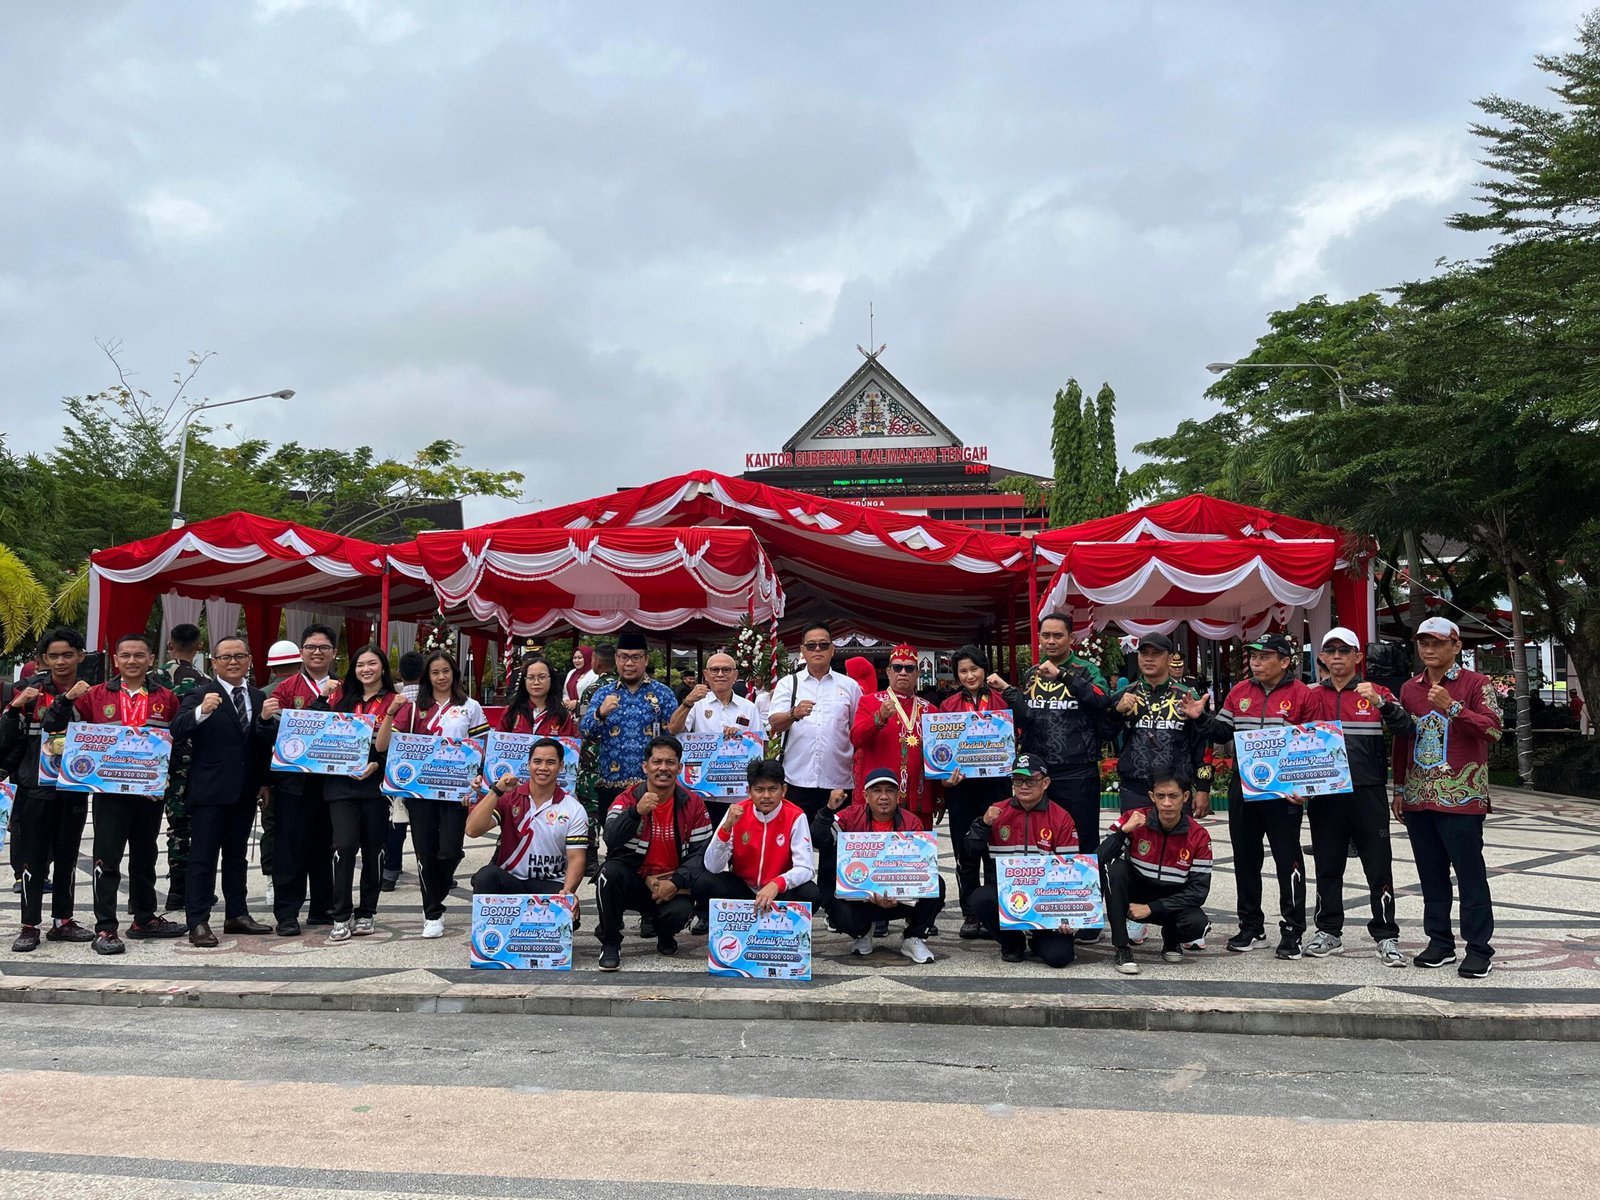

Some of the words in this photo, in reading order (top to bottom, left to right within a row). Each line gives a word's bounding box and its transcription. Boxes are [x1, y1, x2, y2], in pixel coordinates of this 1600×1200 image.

[746, 452, 793, 467] KANTOR
[796, 450, 856, 467] GUBERNUR
[861, 448, 937, 465] KALIMANTAN
[941, 446, 987, 462] TENGAH
[1024, 700, 1078, 709] ALTENG
[287, 719, 325, 729] BONUS
[930, 722, 966, 732] BONUS
[74, 734, 118, 745] BONUS
[1245, 738, 1286, 751] BONUS
[396, 743, 434, 754] BONUS
[494, 742, 531, 752] BONUS
[683, 742, 718, 751] BONUS
[1253, 748, 1281, 758] ATLET
[1279, 757, 1309, 768] Medali
[1309, 755, 1335, 765] Perak
[846, 841, 885, 850] BONUS
[1006, 867, 1045, 877] BONUS
[1035, 888, 1060, 896] Medali
[1060, 888, 1092, 898] Perunggu
[481, 906, 520, 916] BONUS
[487, 917, 515, 925] ATLET
[718, 912, 757, 922] BONUS
[723, 923, 752, 931] ATLET
[510, 928, 538, 938] Medali
[538, 929, 560, 938] Perak
[746, 935, 776, 945] Medali
[776, 936, 800, 947] Perak
